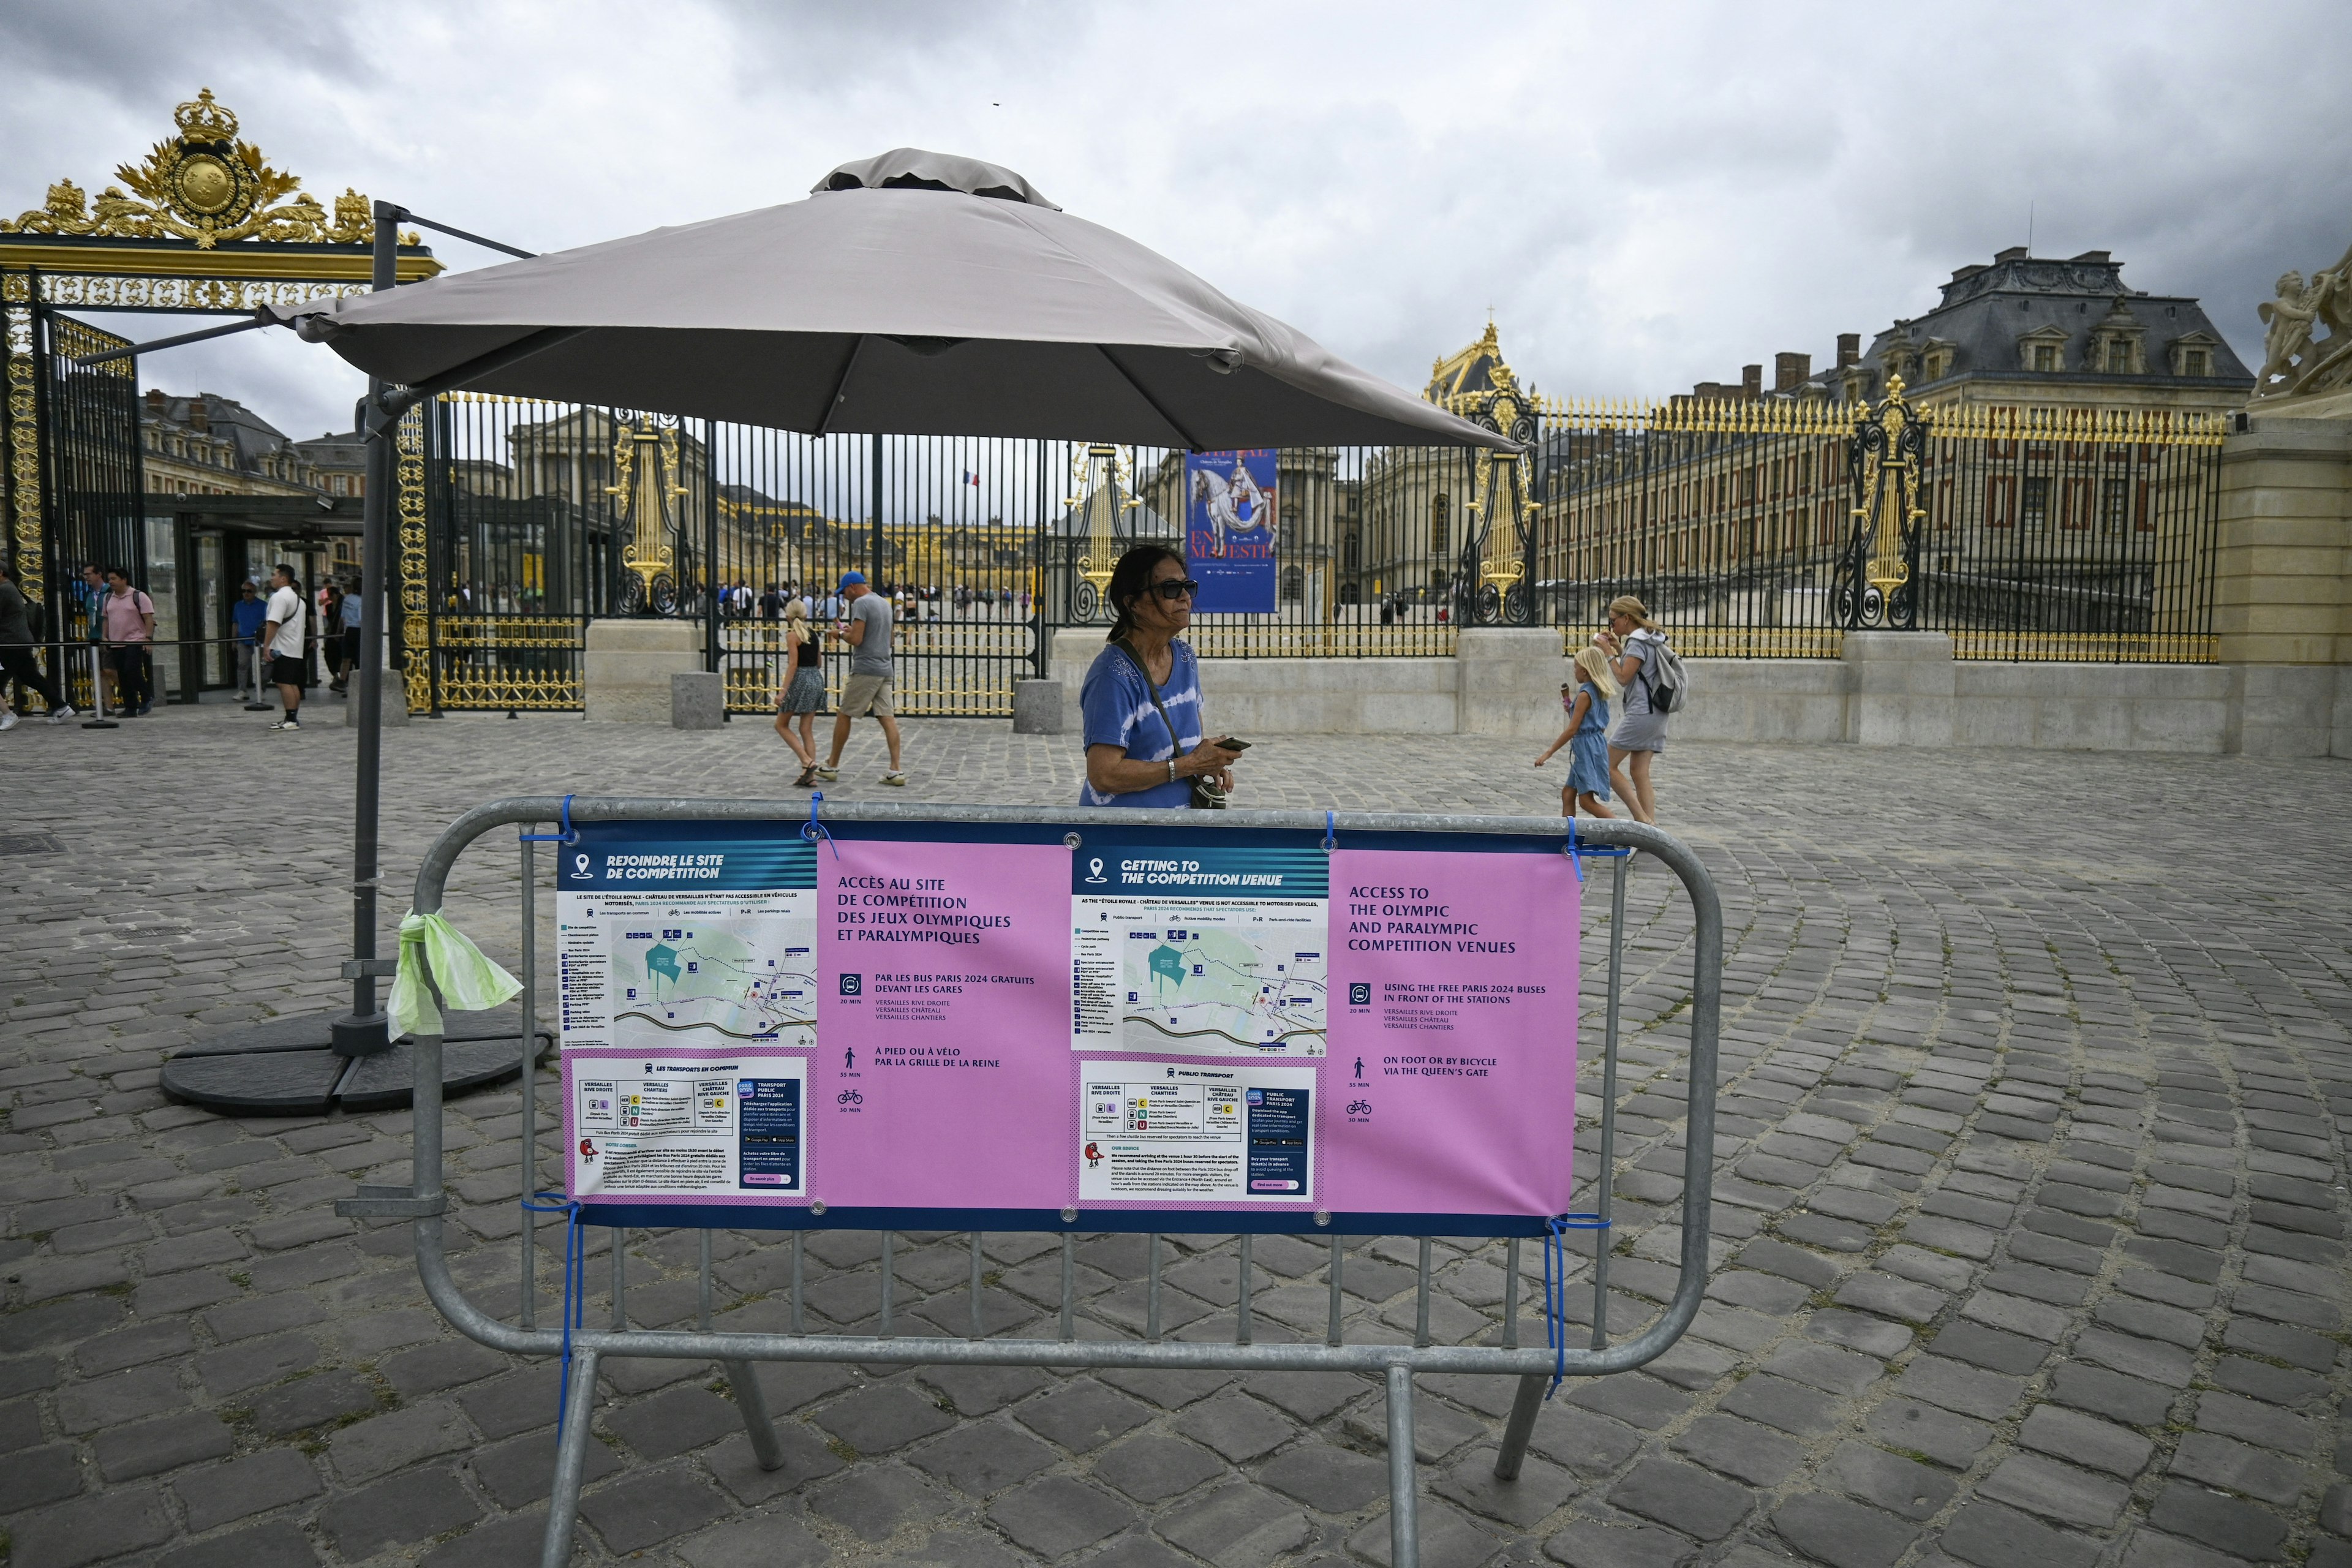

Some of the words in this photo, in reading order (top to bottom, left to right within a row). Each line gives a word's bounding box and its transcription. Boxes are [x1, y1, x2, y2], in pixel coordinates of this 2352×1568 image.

[606, 855, 677, 866] REJOINDRE
[679, 855, 694, 865] LE
[696, 854, 724, 865] SITE
[1121, 860, 1178, 872] GETTING
[1182, 861, 1199, 872] TO
[606, 869, 624, 879] DE
[625, 863, 720, 879] COMPÉTITION
[838, 875, 884, 889] ACCÈS
[889, 878, 910, 890] AU
[916, 879, 945, 891] SITE
[1121, 872, 1145, 883] THE
[1147, 873, 1240, 885] COMPETITION
[1241, 875, 1283, 886] VENUE
[1349, 886, 1404, 899] ACCESS
[1409, 888, 1428, 899] TO
[838, 894, 857, 905] DE
[863, 894, 966, 908] COMPÉTITION
[1349, 904, 1377, 915] THE
[1382, 905, 1449, 917] OLYMPIC
[838, 912, 865, 923] DES
[870, 913, 908, 924] JEUX
[913, 913, 1010, 929] OLYMPIQUES
[1349, 922, 1381, 933] AND
[1388, 922, 1478, 935] PARALYMPIC
[838, 929, 853, 940] ET
[858, 930, 979, 945] PARALYMPIQUES
[1348, 939, 1451, 952] COMPETITION
[1457, 941, 1515, 953] VENUES
[991, 976, 1034, 984] GRATUITS
[875, 1046, 881, 1055] À
[927, 1047, 933, 1055] À
[937, 1047, 960, 1056] VÉLO
[1422, 1068, 1463, 1076] QUEEN'S
